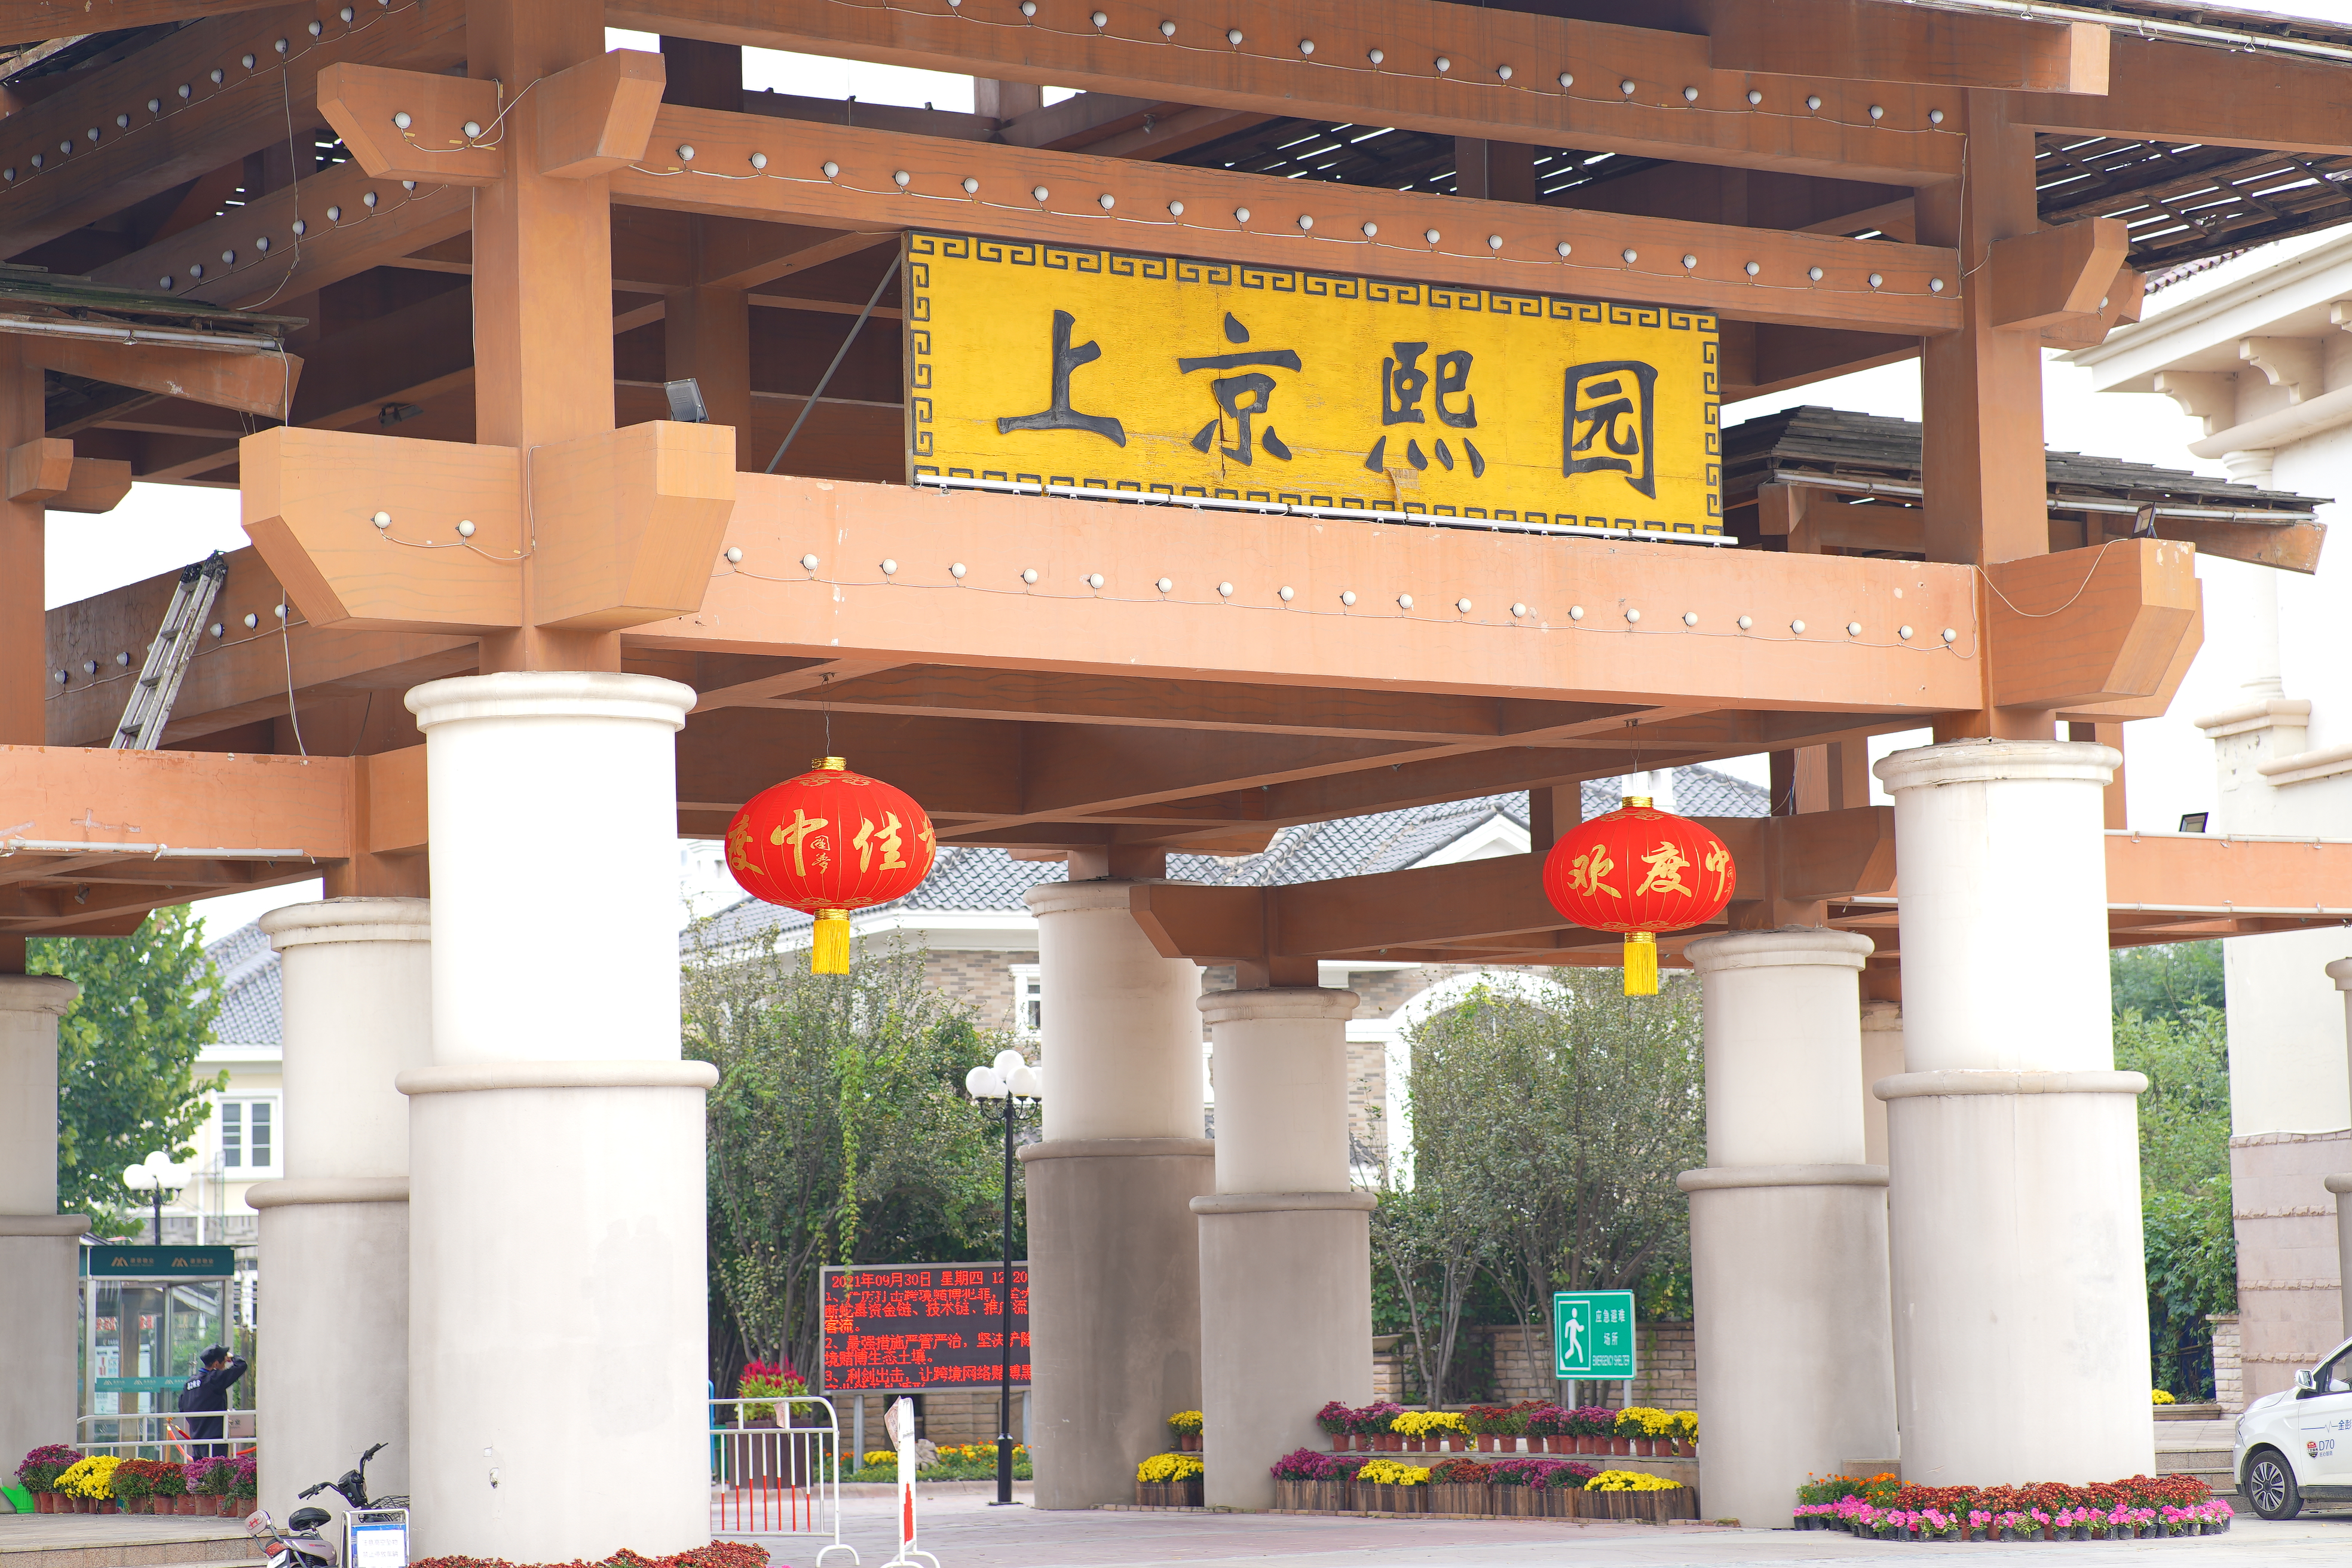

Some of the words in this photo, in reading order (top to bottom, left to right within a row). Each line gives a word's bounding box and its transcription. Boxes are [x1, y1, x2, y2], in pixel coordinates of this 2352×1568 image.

[997, 309, 1658, 500] 上京熙园
[832, 1272, 931, 1288] 2021年09月30日
[941, 1270, 984, 1286] 星期四
[992, 1271, 1028, 1283] 1220
[1595, 1309, 1625, 1323] 应急避难
[1604, 1332, 1618, 1346] 场所
[2319, 1439, 2335, 1451] D70
